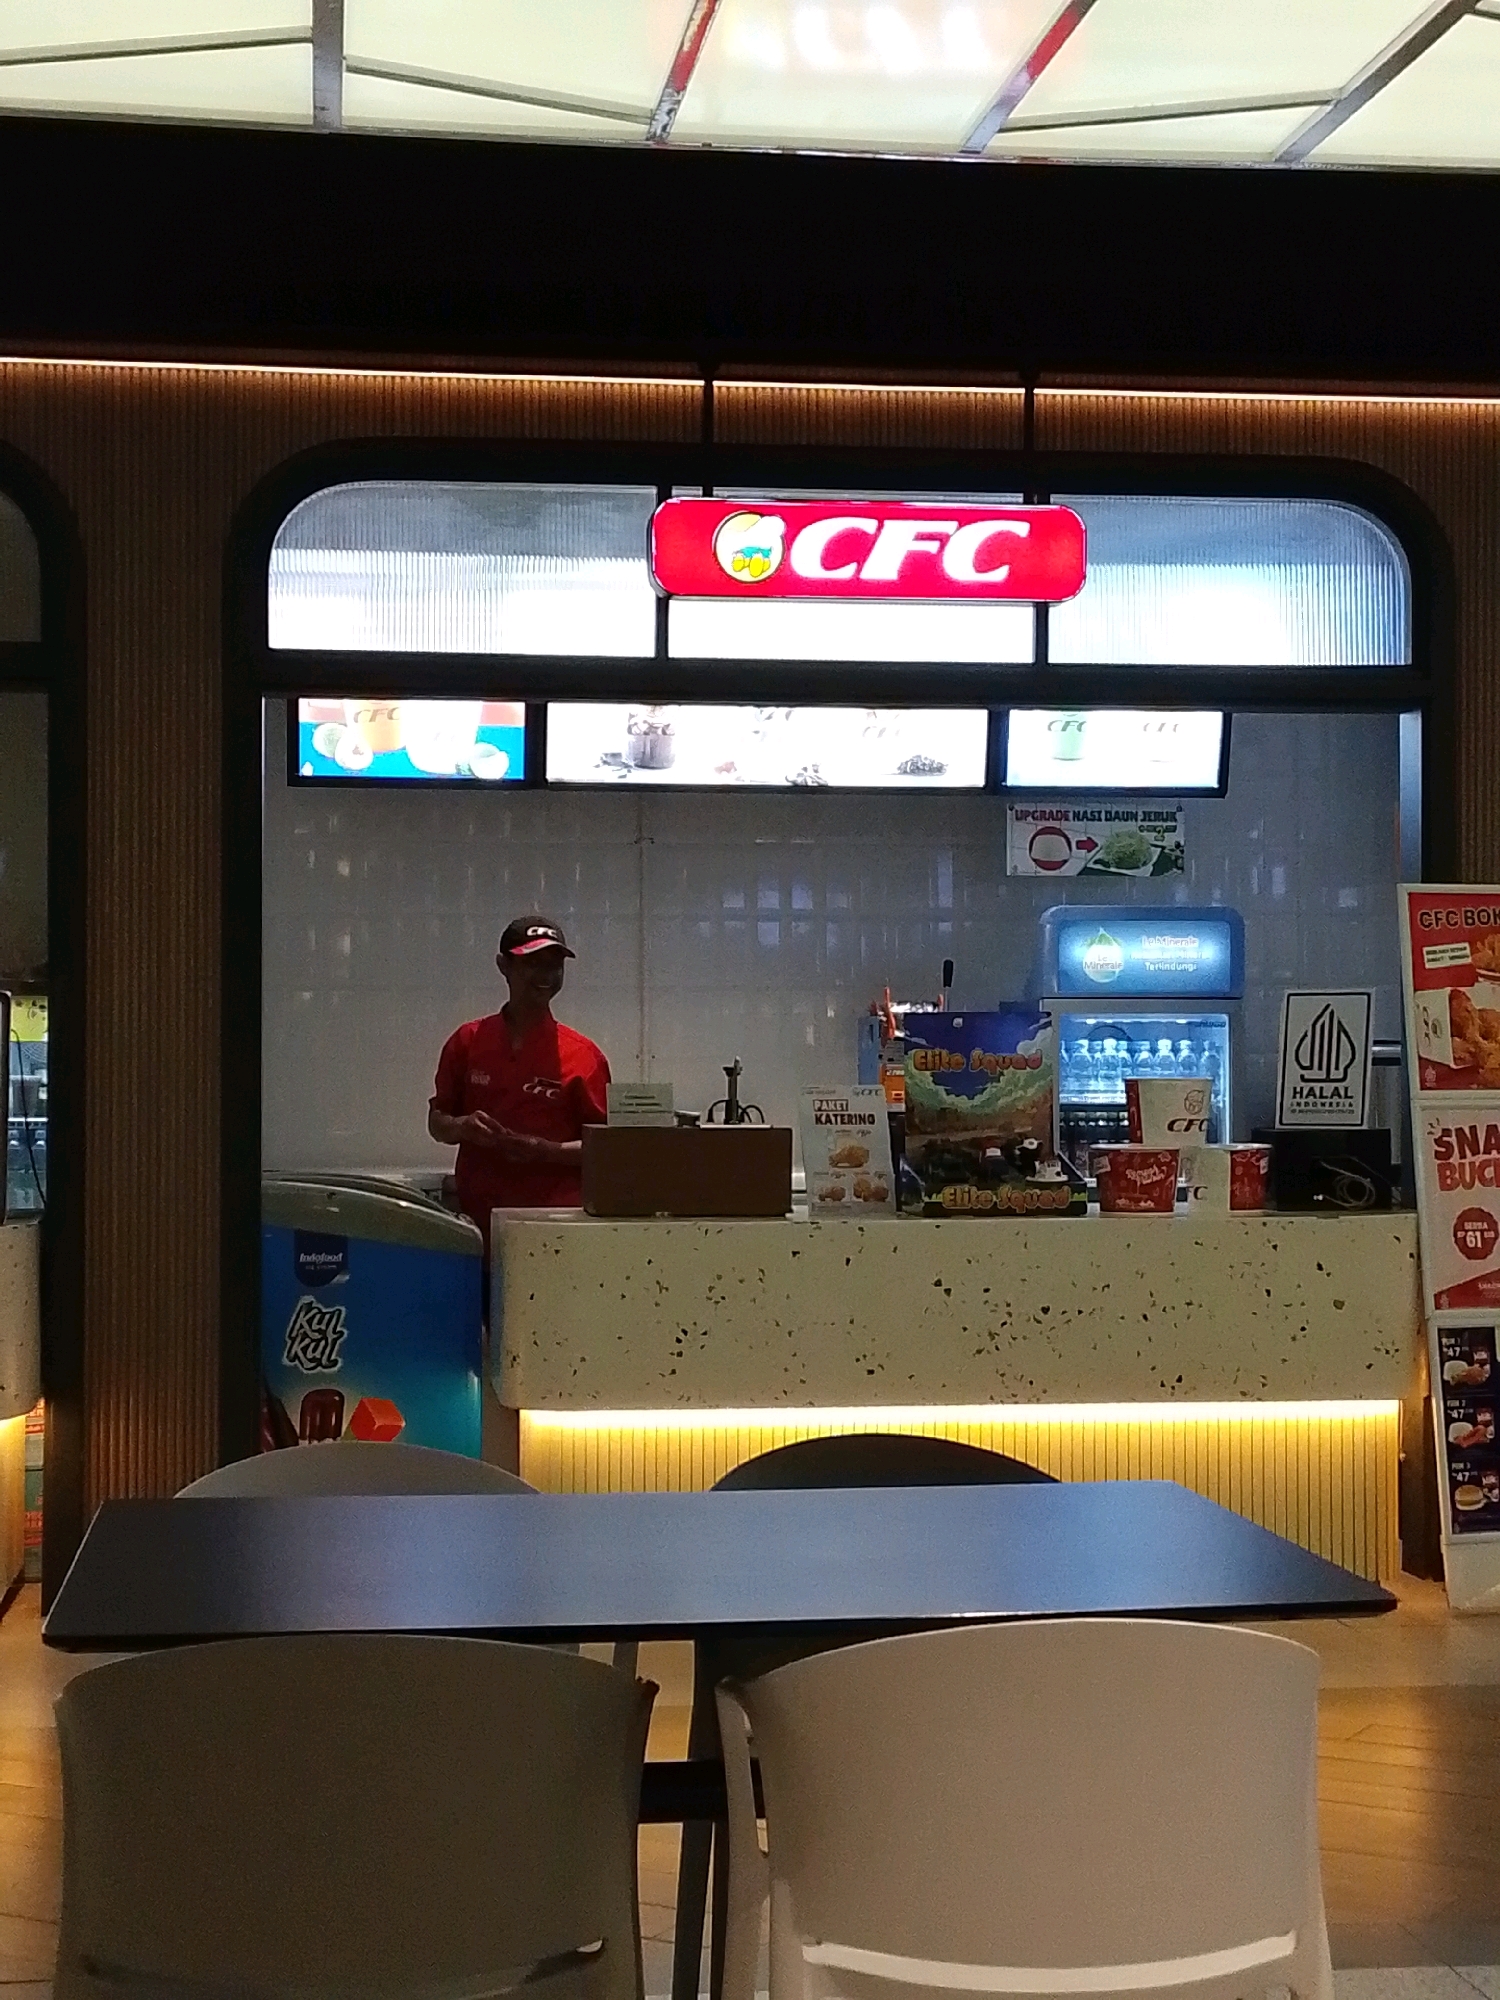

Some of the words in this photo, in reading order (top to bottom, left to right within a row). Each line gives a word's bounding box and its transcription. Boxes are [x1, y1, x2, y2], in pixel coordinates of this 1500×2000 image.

[789, 516, 1030, 581] CFC
[1014, 809, 1070, 822] UPGRADE
[1072, 810, 1102, 822] NASI
[1105, 810, 1138, 822] DAUN
[1419, 910, 1459, 929] CFC
[526, 926, 557, 938] CFC
[913, 1049, 966, 1072] Elite
[970, 1047, 1043, 1074] Squad
[522, 1082, 560, 1099] CFC
[1292, 1086, 1354, 1099] HALAL
[814, 1099, 848, 1111] PAKET
[942, 1186, 996, 1209] Elite
[997, 1184, 1072, 1213] Squad
[1466, 1231, 1482, 1248] 61
[299, 1252, 343, 1263] Indofood
[285, 1331, 342, 1371] Kul
[1447, 1346, 1461, 1357] 47
[1456, 1471, 1470, 1482] 47
